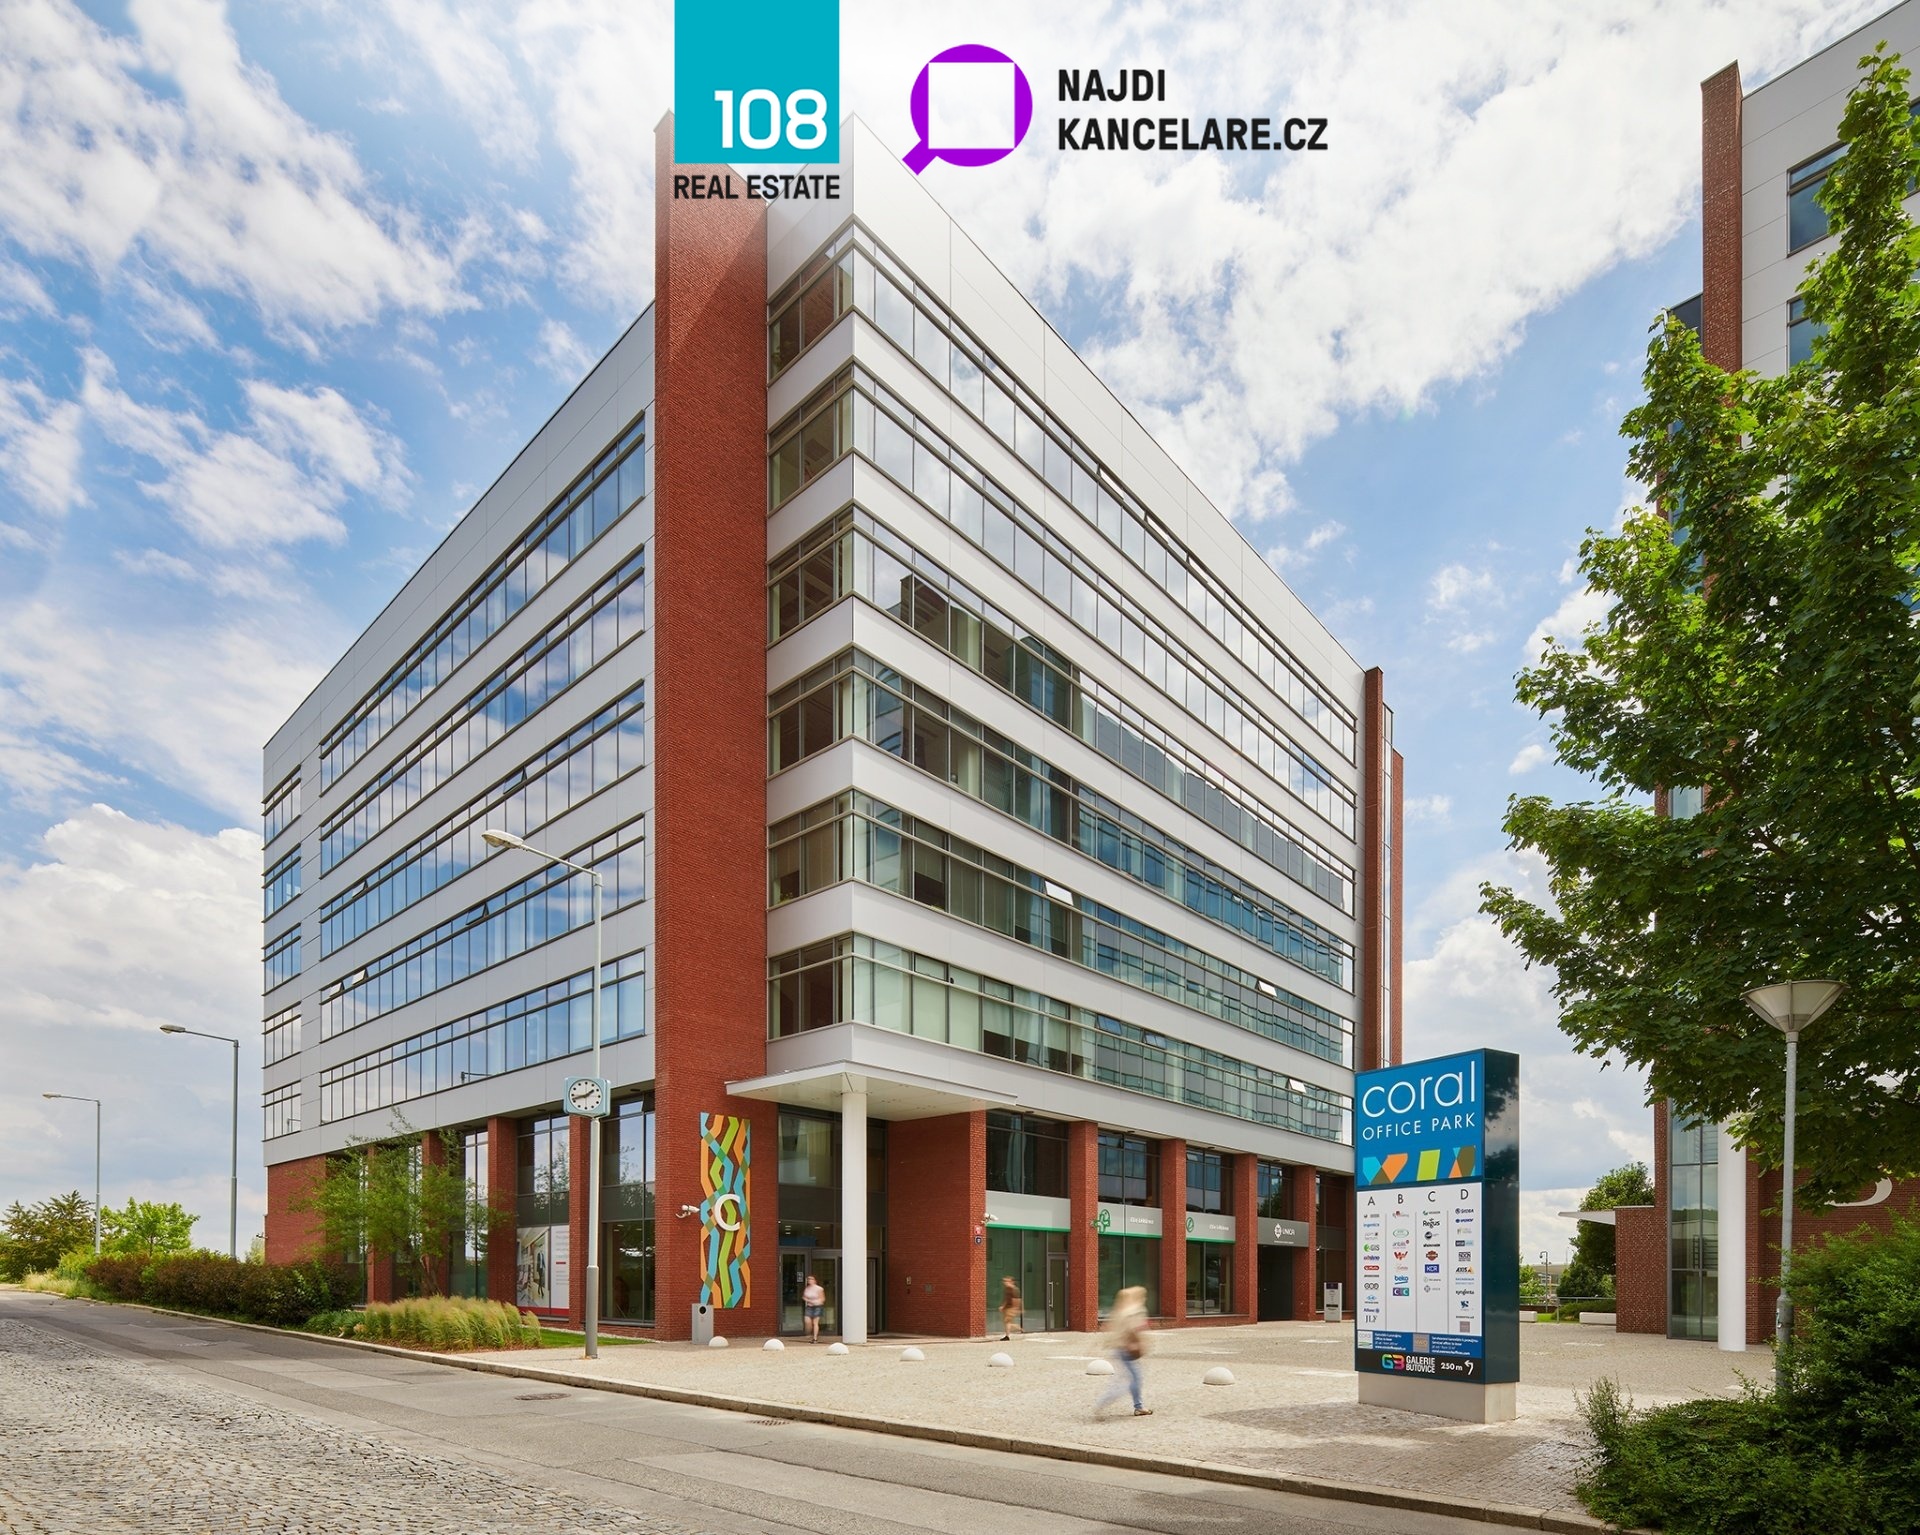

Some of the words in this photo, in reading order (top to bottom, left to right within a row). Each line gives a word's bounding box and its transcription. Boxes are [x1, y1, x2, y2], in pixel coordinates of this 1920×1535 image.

[1362, 1060, 1476, 1118] coral
[1362, 1120, 1422, 1141] OFFICE
[1431, 1112, 1476, 1132] PARK
[1367, 1196, 1376, 1206] A
[1397, 1193, 1404, 1205] B
[1427, 1190, 1436, 1203] C
[1460, 1188, 1469, 1200] D
[715, 1193, 741, 1232] C
[1405, 1355, 1436, 1367] GALERIE
[1405, 1363, 1436, 1374] BUTOVICE
[1440, 1362, 1455, 1371] 250
